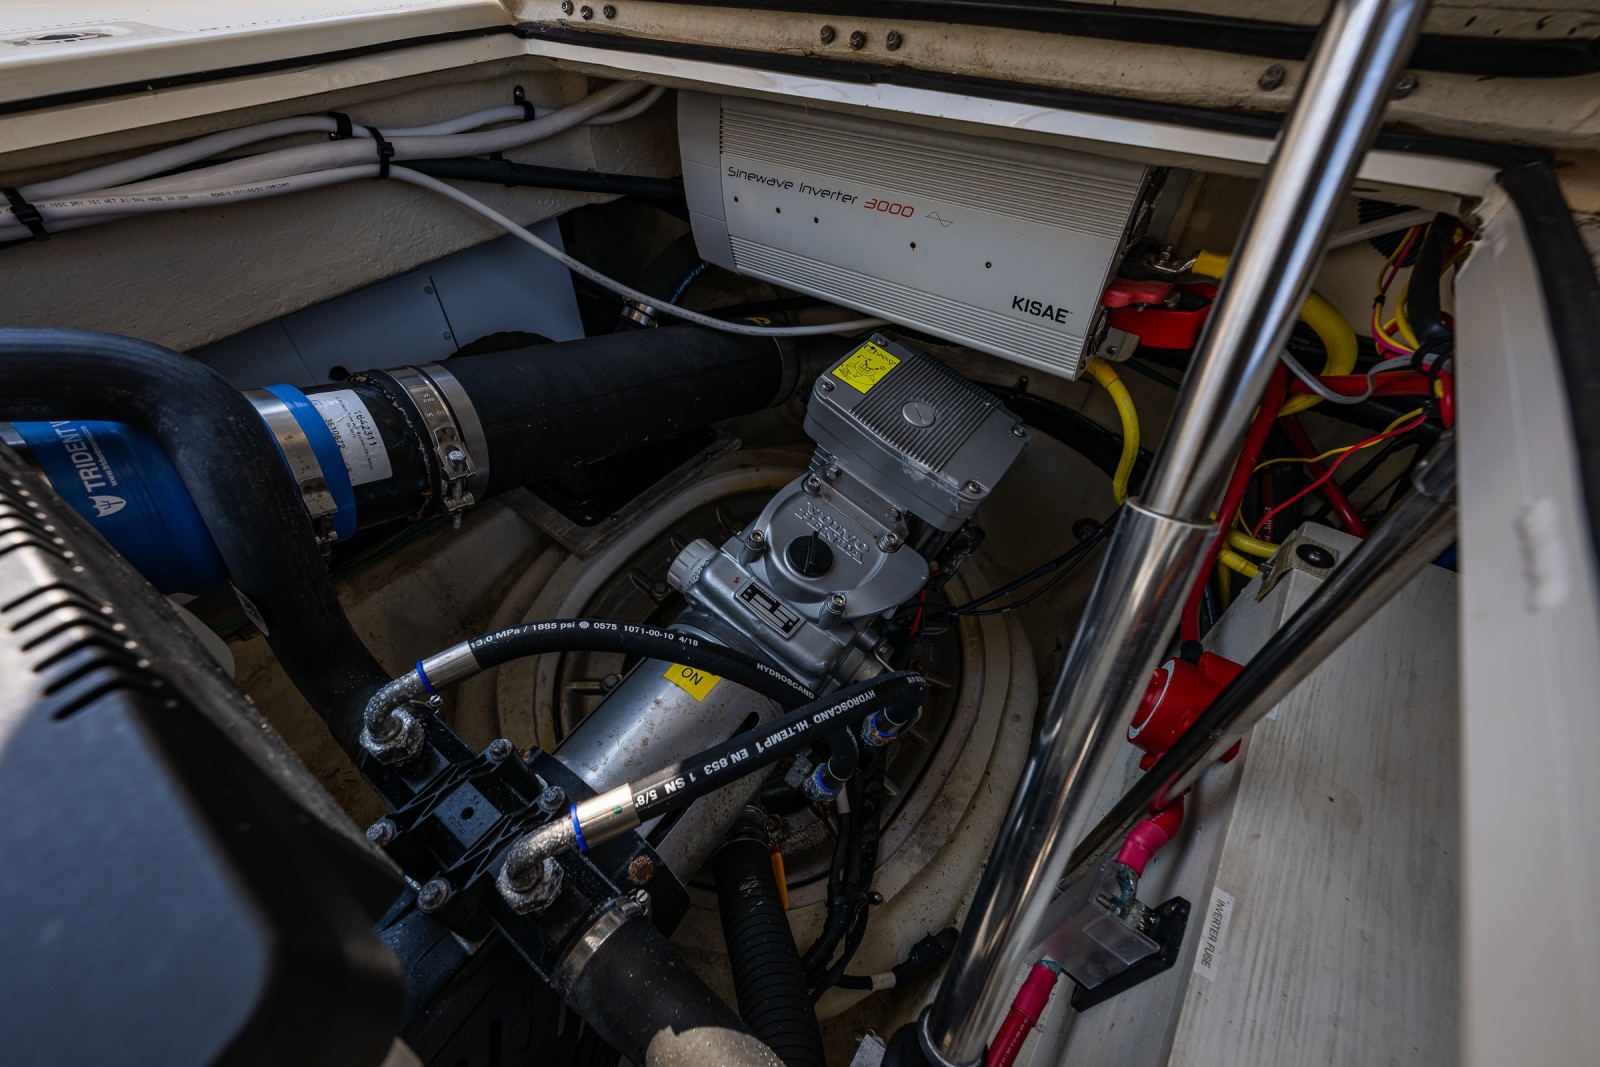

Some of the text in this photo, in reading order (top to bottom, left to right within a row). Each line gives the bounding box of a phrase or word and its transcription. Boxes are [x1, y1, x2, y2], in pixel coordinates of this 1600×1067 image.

[728, 166, 915, 218] Sinewave Inverter 3000
[1011, 295, 1070, 324] KISAE
[54, 428, 106, 493] TRIDENT
[794, 507, 864, 565] PENTA
[806, 501, 870, 554] VOLVO
[495, 628, 520, 640] MPa
[532, 622, 557, 631] 1885
[560, 621, 575, 630] psi
[593, 622, 699, 647] 0575 1071-00-10 4/18
[756, 662, 814, 700] HYDROSCAND
[813, 689, 876, 725] HYDROSCAND
[757, 718, 809, 754] HI-TEMP1
[703, 757, 729, 775] 853
[730, 747, 750, 764] EN
[664, 776, 686, 794] SN
[688, 772, 697, 783] 1
[1201, 899, 1226, 969] INVERTER FUSE
